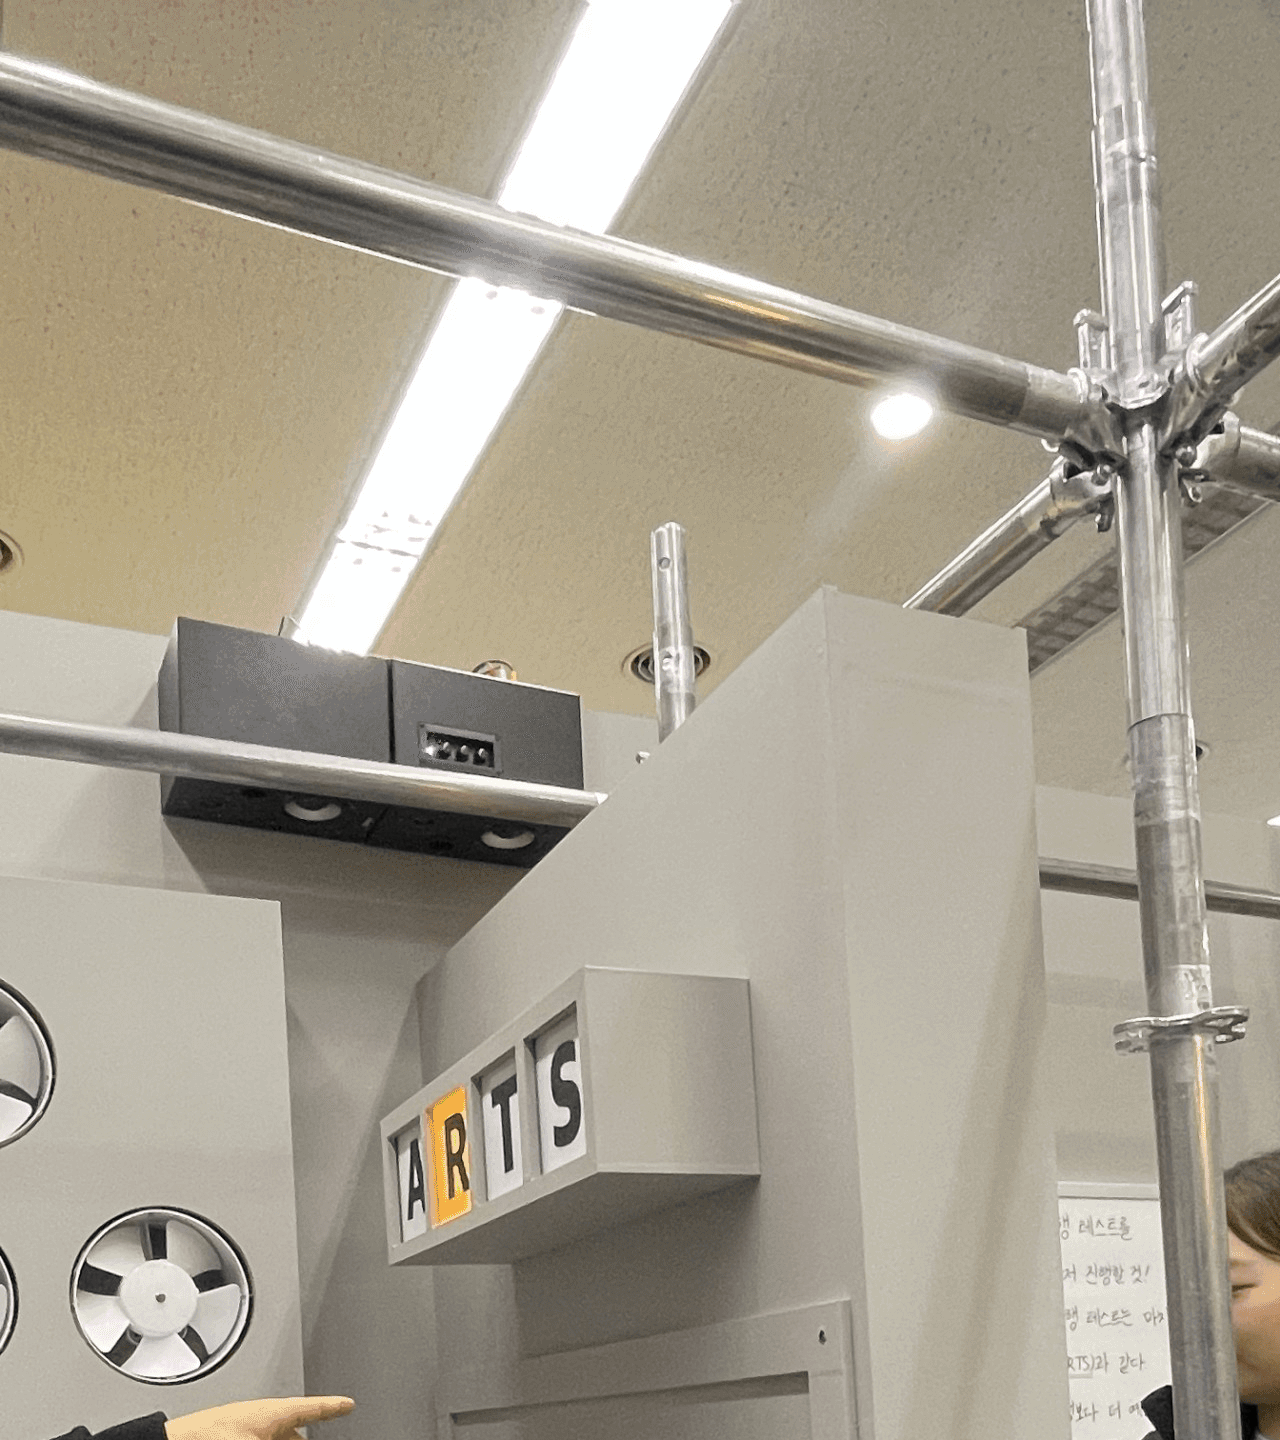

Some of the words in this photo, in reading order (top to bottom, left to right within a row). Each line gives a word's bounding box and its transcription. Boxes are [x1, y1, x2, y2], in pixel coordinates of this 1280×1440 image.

[407, 1039, 582, 1221] ARTS
[1078, 1215, 1133, 1241] 테스트를
[1086, 1307, 1133, 1328] 테스트는
[1108, 1401, 1122, 1420] 더
